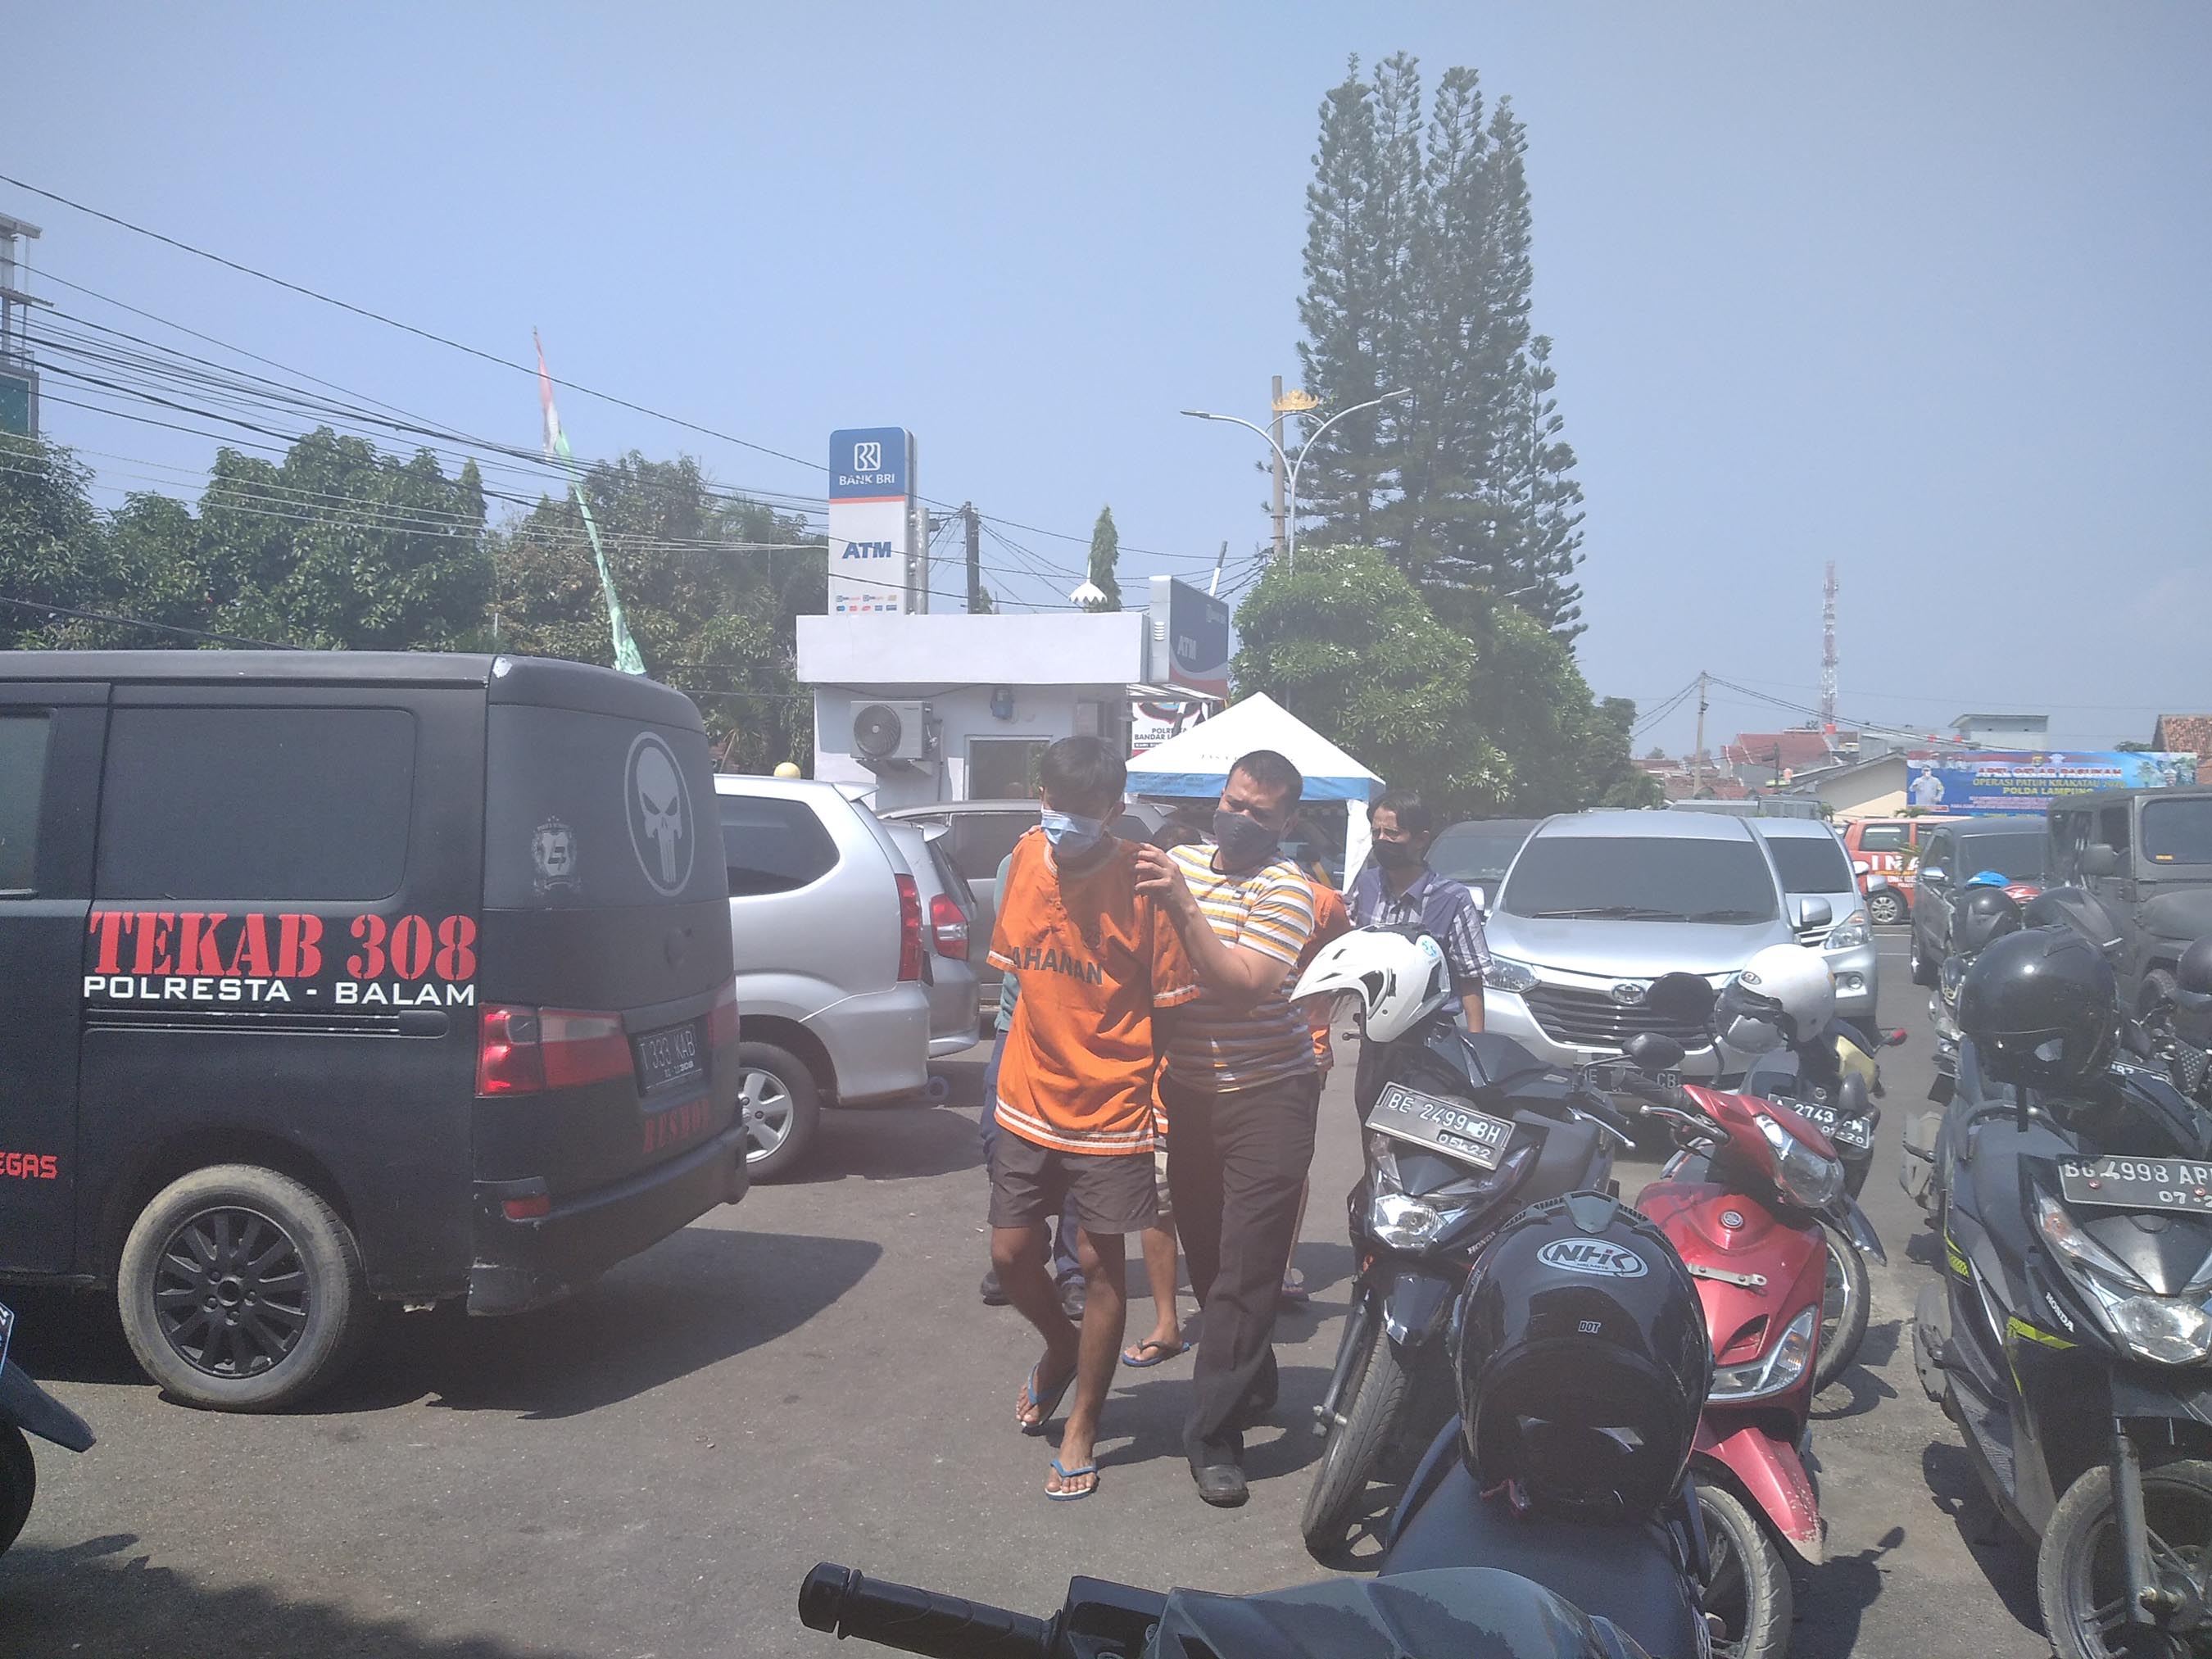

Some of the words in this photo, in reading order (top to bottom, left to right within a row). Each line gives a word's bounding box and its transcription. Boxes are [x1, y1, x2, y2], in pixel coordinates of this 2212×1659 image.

[839, 475, 873, 486] BANK
[876, 474, 895, 484] BRI
[842, 541, 891, 559] ATM
[1973, 778, 2015, 787] OPERASI
[2016, 779, 2047, 787] PATUH
[2048, 779, 2099, 787] KRAKATAU
[2060, 767, 2122, 778] PASUKAN
[89, 911, 324, 979] TEKAB
[347, 914, 477, 981] 308
[1013, 946, 1103, 985] AHANAN
[84, 977, 291, 1002] POLRESTA
[335, 982, 474, 1006] BALAM
[673, 1030, 696, 1059] KAB
[1657, 1072, 1676, 1089] CB
[1388, 1092, 1415, 1114] BE
[1420, 1104, 1468, 1131] 2499
[2100, 1161, 2169, 1182] 4998
[1466, 1231, 1497, 1255] HONDA
[1550, 1244, 1633, 1271] NHK
[2045, 1291, 2074, 1333] HONDA
[1578, 1320, 1602, 1334] DOT
